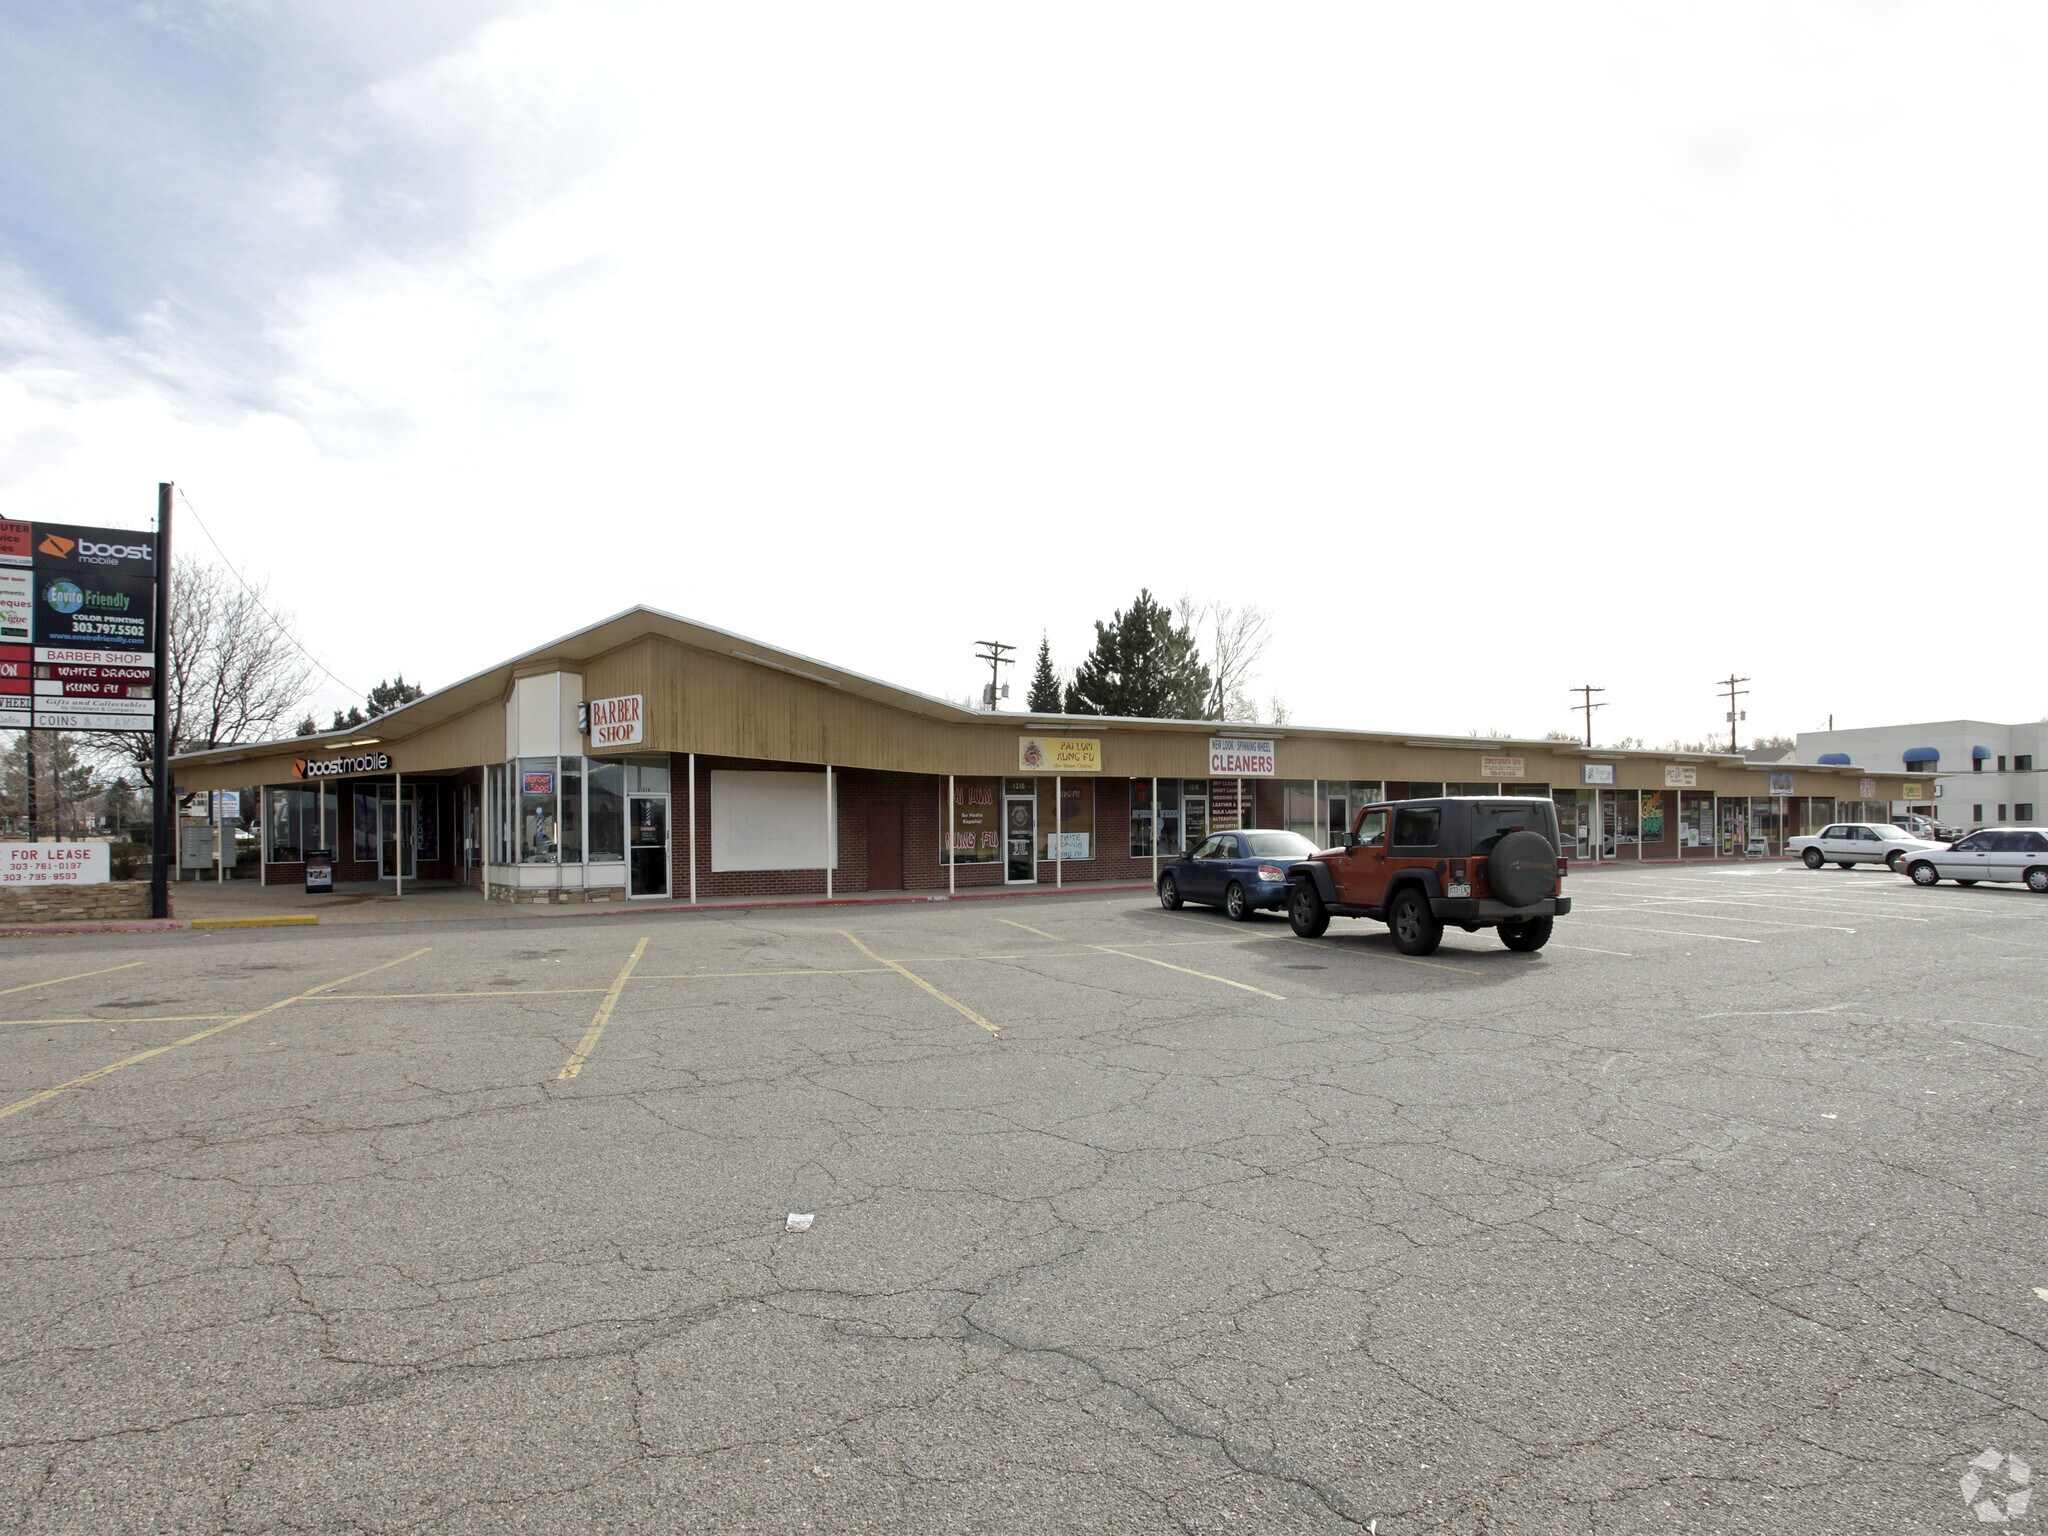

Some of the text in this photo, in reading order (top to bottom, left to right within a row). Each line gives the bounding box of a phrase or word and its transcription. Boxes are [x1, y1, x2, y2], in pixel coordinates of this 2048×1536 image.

[78, 538, 152, 560] boost
[79, 556, 118, 566] mobile
[51, 586, 83, 603] Enviro
[85, 589, 130, 611] Friendly
[72, 613, 145, 625] COLOR PRINTING
[72, 621, 145, 636] 303.797.5502
[49, 632, 145, 645] www.envirofriendly.com
[47, 650, 142, 664] BARBER SHOP
[0, 663, 18, 677] ON
[58, 666, 150, 679] WHITE DRAGON
[65, 682, 119, 693] KUNG FU
[46, 698, 69, 706] Gifts
[92, 700, 147, 708] Collectables
[593, 697, 641, 726] BARBER
[40, 715, 78, 726] COINS
[84, 717, 91, 726] &
[599, 723, 634, 743] SHOP
[1060, 741, 1093, 751] PAI LUM
[1057, 752, 1095, 761] KUNG FU
[1212, 754, 1273, 773] CLEANERS
[525, 774, 550, 783] Barber
[531, 783, 549, 793] Shop
[981, 831, 1000, 849] FU
[11, 849, 91, 860] FOR LEASE
[1055, 850, 1072, 858] UNG
[10, 862, 82, 871] 303-761-0197
[3, 872, 77, 881] 303-795-9593
